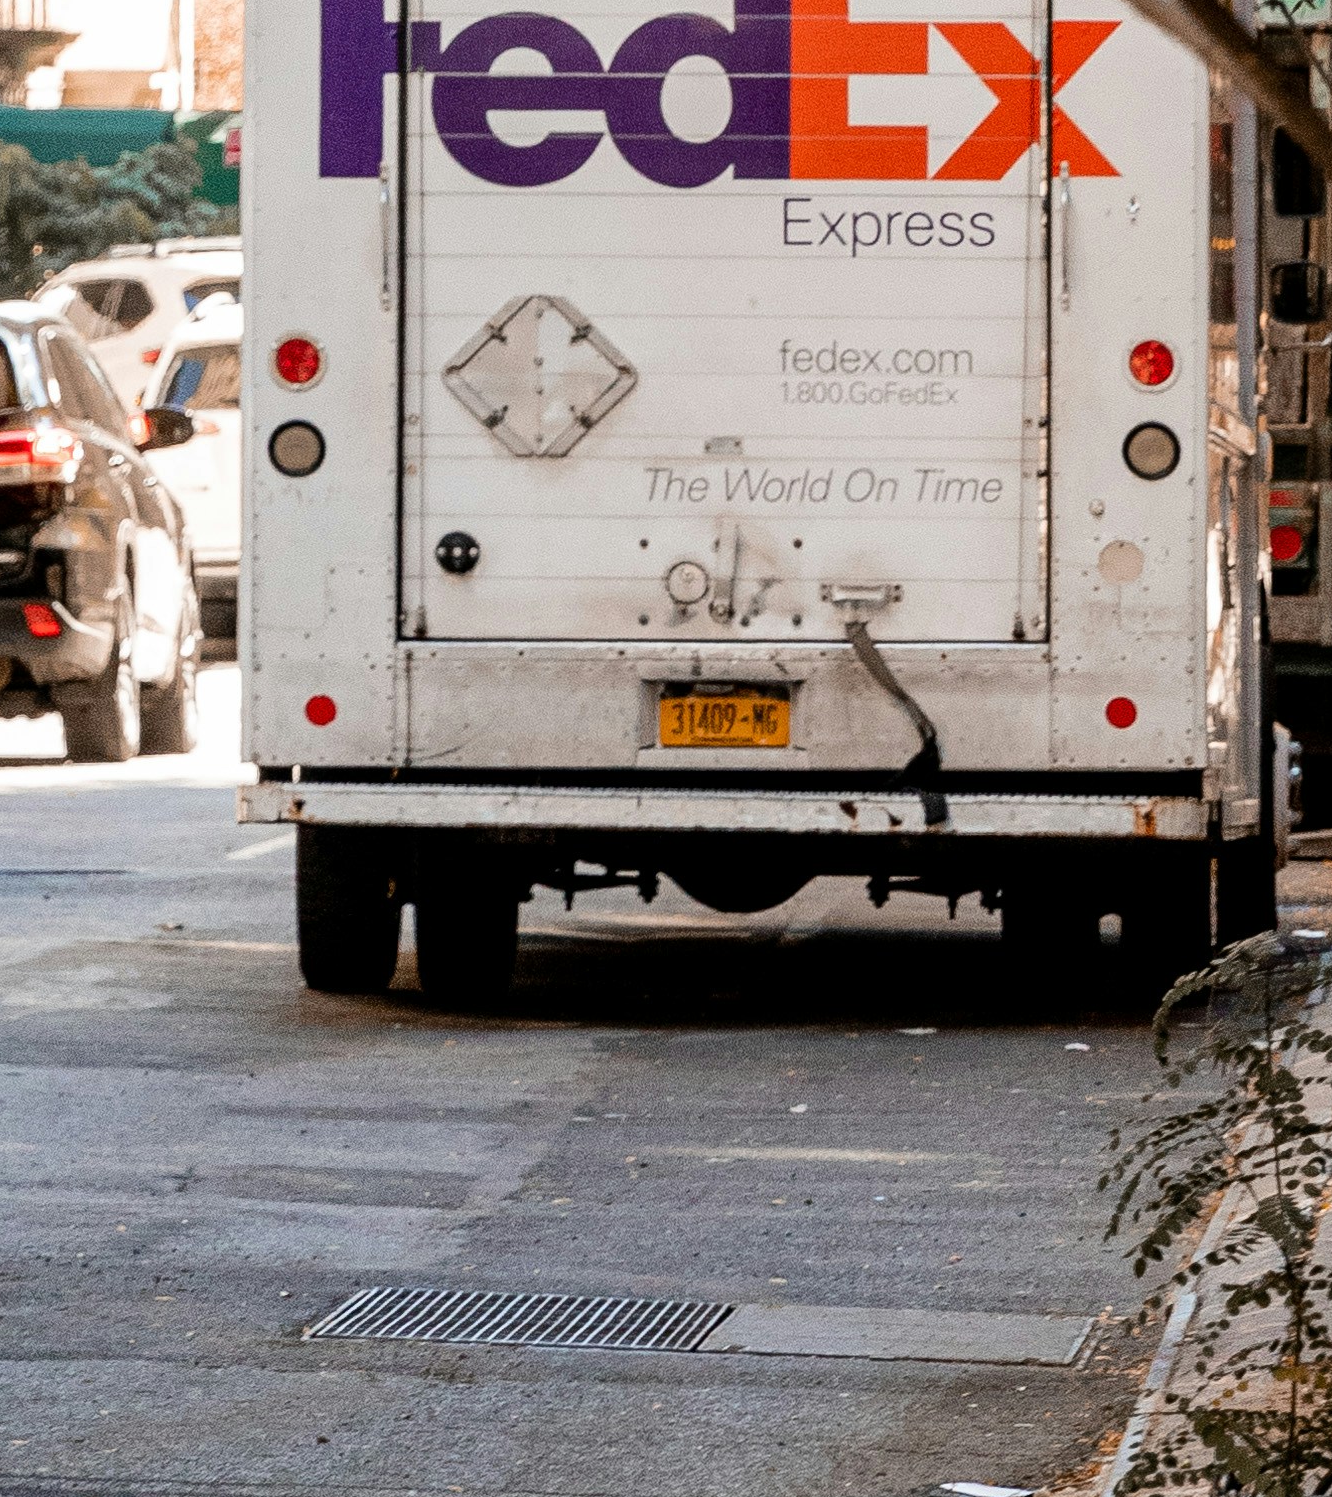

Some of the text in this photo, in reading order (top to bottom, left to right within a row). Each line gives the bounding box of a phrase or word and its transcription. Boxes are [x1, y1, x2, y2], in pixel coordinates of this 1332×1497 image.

[782, 197, 997, 258] Express
[779, 339, 974, 376] fedex.com
[780, 380, 960, 406] 1.800.GoFedEx
[644, 467, 1004, 503] The World On Time
